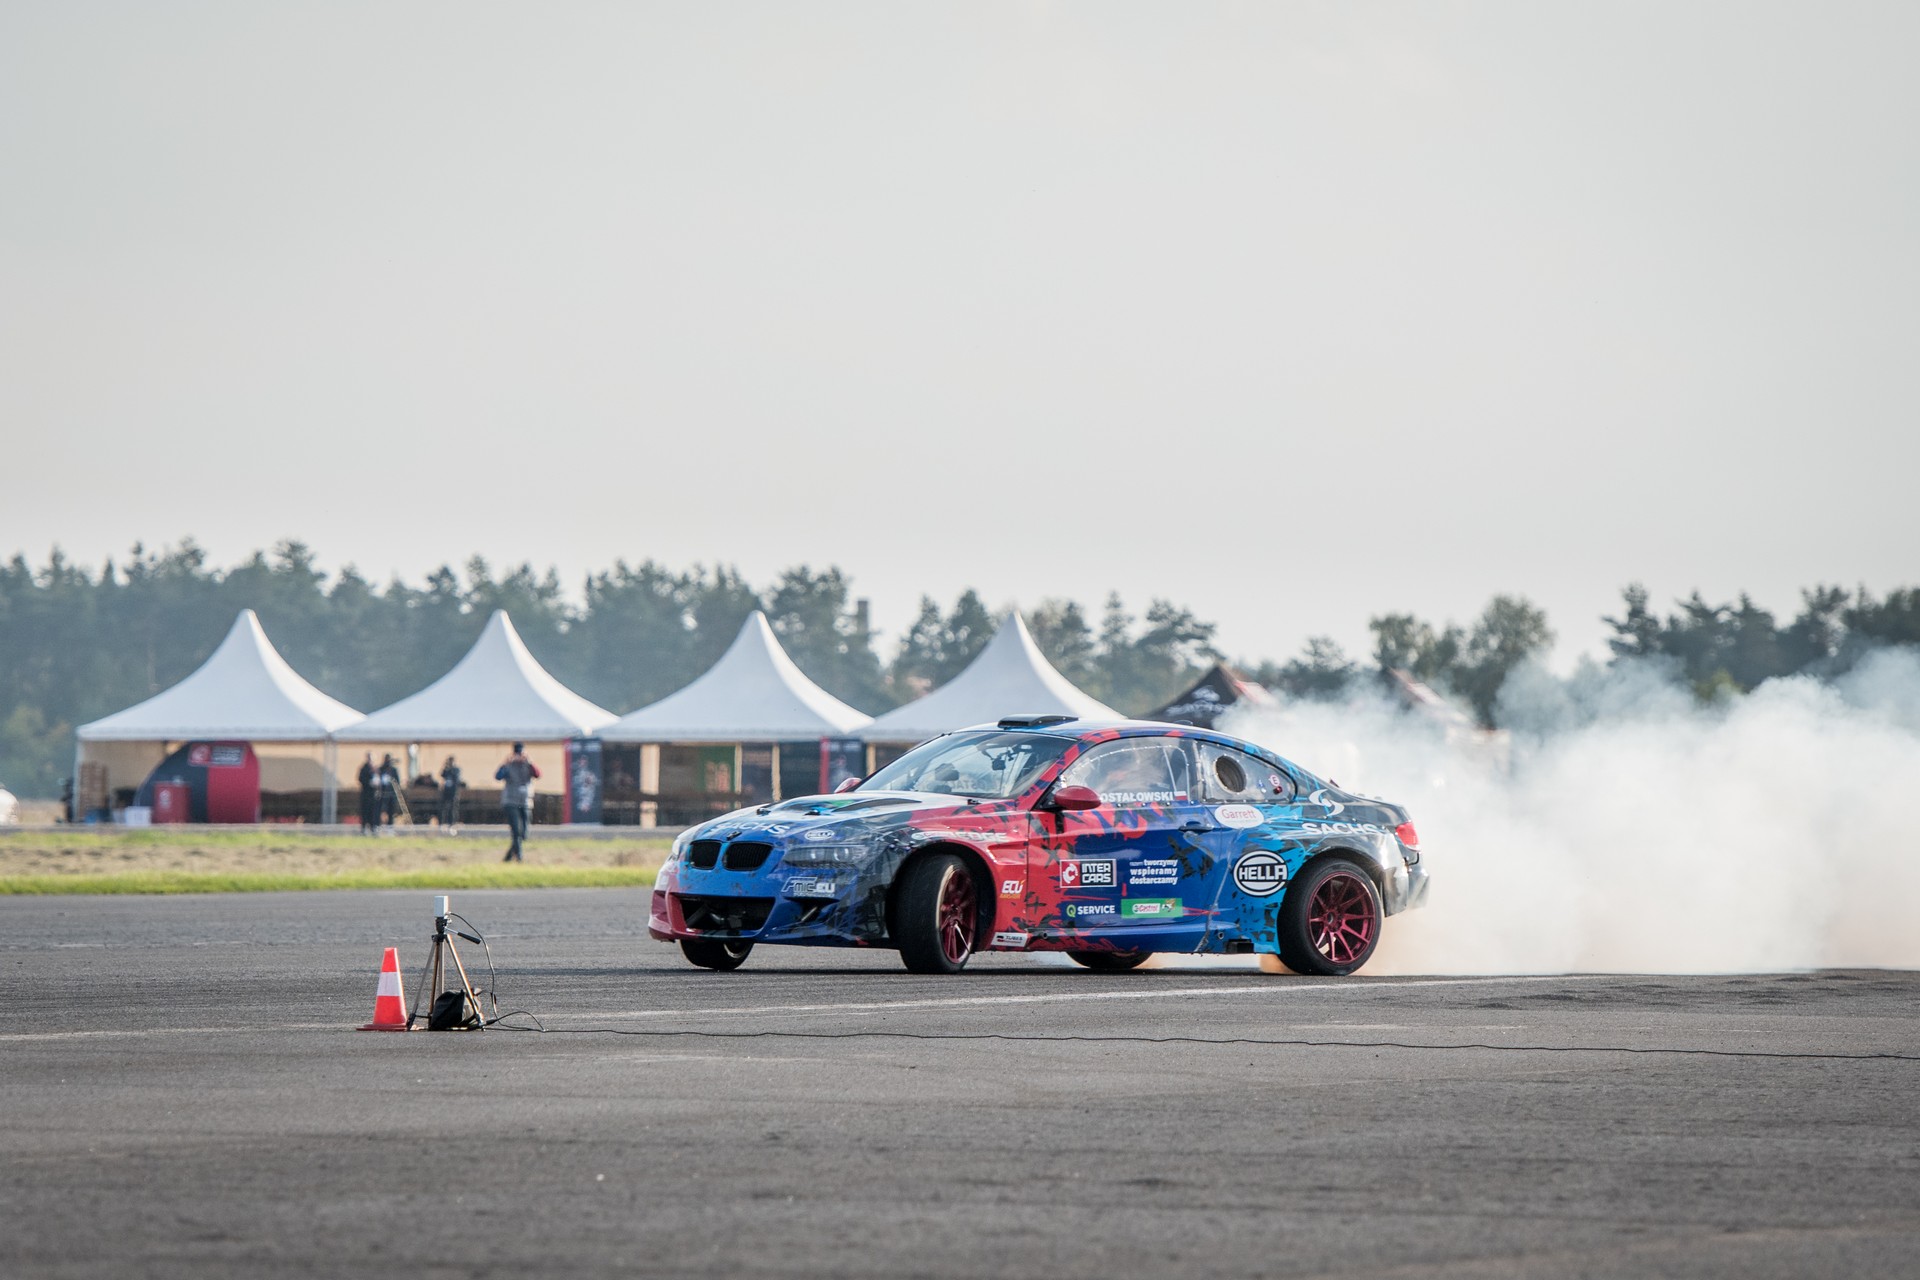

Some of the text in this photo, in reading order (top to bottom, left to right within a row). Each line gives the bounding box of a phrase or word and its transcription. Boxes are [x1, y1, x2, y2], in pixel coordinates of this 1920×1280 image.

[1101, 792, 1174, 802] OSTAŁOWSKI
[1221, 808, 1257, 819] Garrett
[1301, 823, 1384, 835] SACHS
[1082, 863, 1111, 872] INTER
[1143, 859, 1178, 867] tworzymy
[1130, 867, 1178, 876] wspieramy
[1238, 864, 1287, 880] HELLA
[1082, 873, 1111, 883] CARS
[1129, 876, 1178, 885] dostarczamy
[1001, 880, 1025, 894] ECU
[1077, 905, 1116, 915] SERVICE
